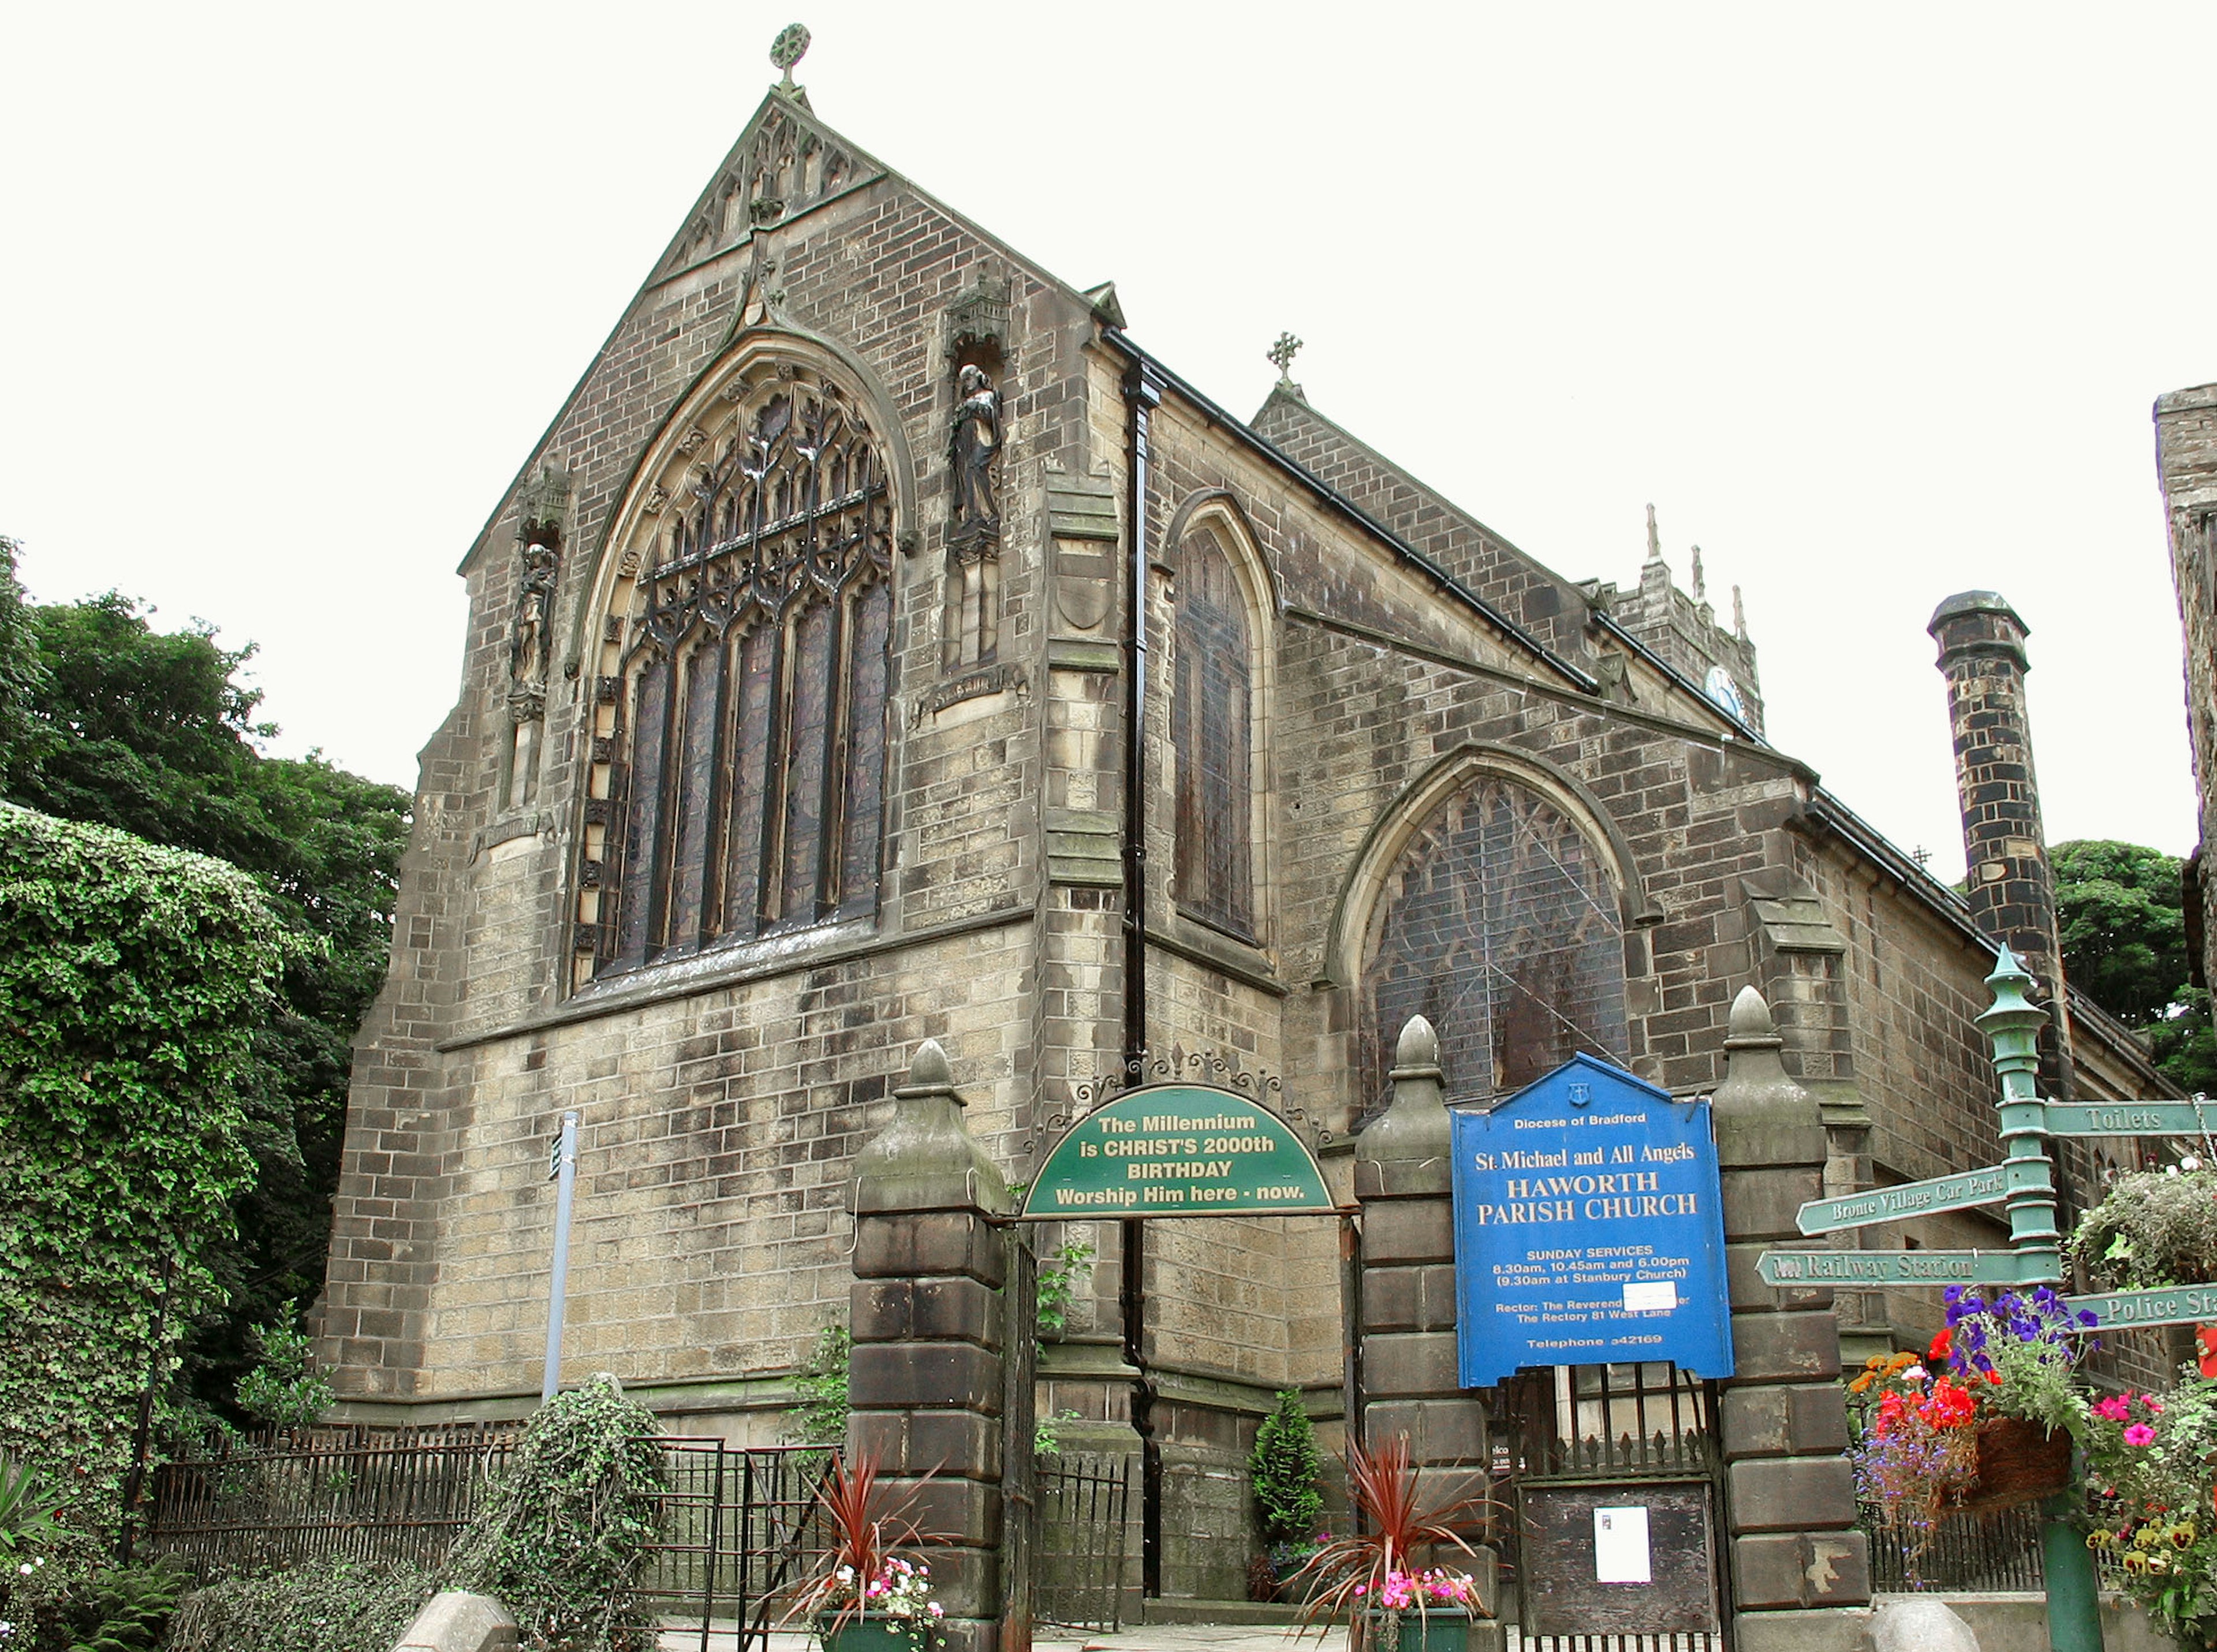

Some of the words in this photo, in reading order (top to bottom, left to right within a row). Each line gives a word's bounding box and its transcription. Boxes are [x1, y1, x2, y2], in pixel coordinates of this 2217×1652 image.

[1099, 1117, 1136, 1133] The
[1143, 1114, 1255, 1133] Millennium
[1514, 1117, 1567, 1130] Diocese
[1571, 1115, 1585, 1127] of
[1589, 1113, 1646, 1126] Bradford
[2085, 1108, 2162, 1131] Toilets
[1080, 1142, 1097, 1158] is
[1104, 1138, 1197, 1157] CHRIST'S
[1204, 1137, 1275, 1153] 2000th
[1475, 1152, 1497, 1171] St.
[1502, 1149, 1567, 1169] Michael
[1574, 1147, 1603, 1165] and
[1609, 1145, 1633, 1164] All
[1640, 1142, 1695, 1163] Angels
[1128, 1161, 1232, 1179] BIRTHDAY
[1056, 1187, 1137, 1206] Worship
[1144, 1186, 1184, 1202] Him
[1190, 1184, 1237, 1201] here
[1257, 1186, 1305, 1200] now.
[1506, 1171, 1659, 1199] HAWORTH
[1879, 1188, 1931, 1211] Village
[1935, 1183, 1963, 1201] Car
[1968, 1173, 2005, 1195] Park
[1477, 1199, 1575, 1225] PARISH
[1585, 1193, 1697, 1220] CHURCH
[1526, 1249, 1582, 1261] SUNDAY
[1586, 1245, 1654, 1258] SERVICES
[1550, 1261, 1604, 1272] 10.45am
[1610, 1258, 1633, 1269] and
[1638, 1256, 1689, 1268] 6.00pm
[1805, 1255, 1890, 1281] Railway
[1899, 1254, 1973, 1278] Station
[1496, 1275, 1551, 1287] (9.30am
[1555, 1273, 1567, 1284] at
[1573, 1272, 1631, 1284] Stanbury
[1636, 1268, 1686, 1280] Church)
[1495, 1304, 1538, 1313] Rector:
[1543, 1302, 1563, 1310] The
[1567, 1299, 1622, 1310] Reverend
[2106, 1298, 2177, 1322] Police
[1517, 1314, 1538, 1324] The
[1542, 1312, 1588, 1322] Rectory
[1608, 1310, 1639, 1319] West
[1526, 1338, 1604, 1350] Telephone
